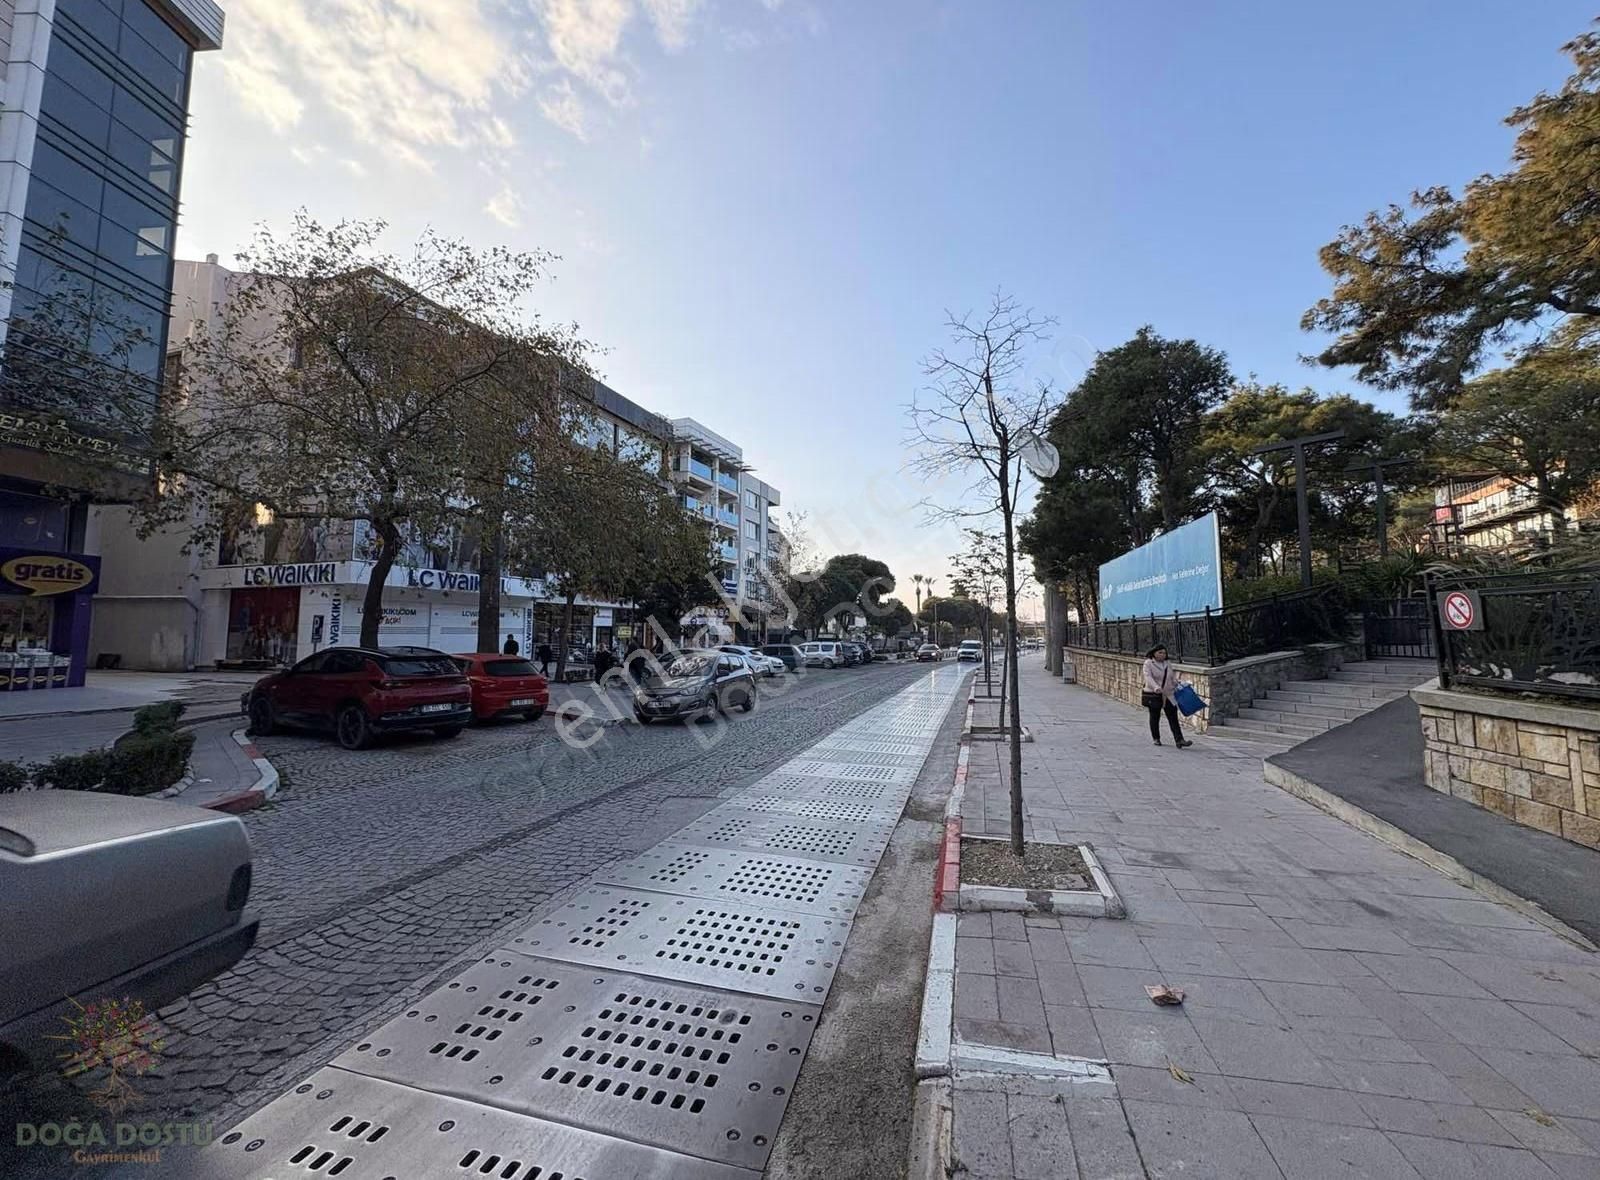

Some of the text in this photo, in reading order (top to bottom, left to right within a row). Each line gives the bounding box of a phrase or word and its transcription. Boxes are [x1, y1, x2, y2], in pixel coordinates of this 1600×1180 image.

[14, 560, 85, 582] gratis
[244, 567, 266, 586] LC
[408, 568, 435, 588] LC
